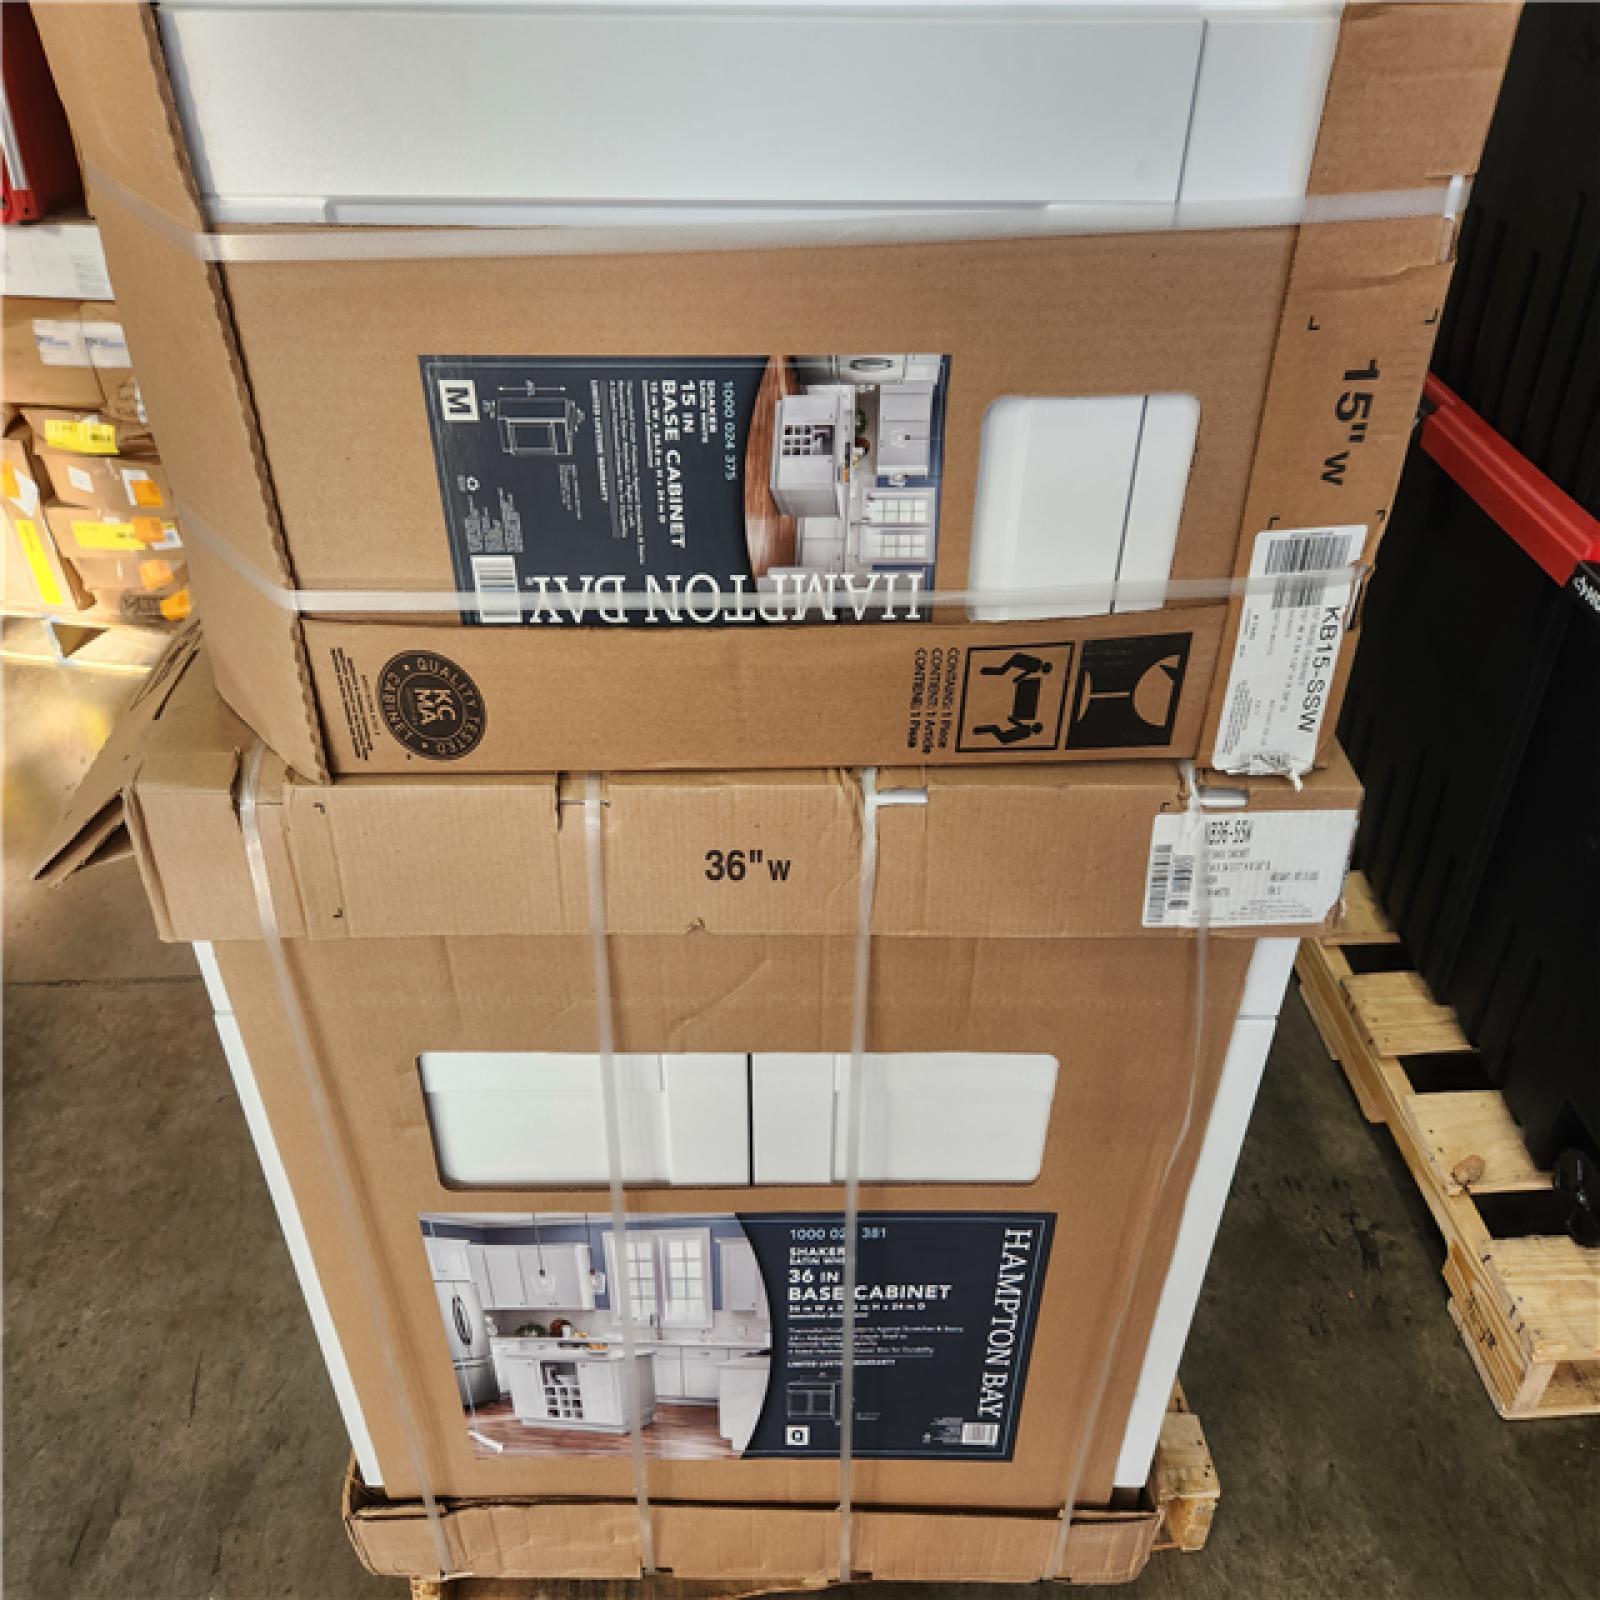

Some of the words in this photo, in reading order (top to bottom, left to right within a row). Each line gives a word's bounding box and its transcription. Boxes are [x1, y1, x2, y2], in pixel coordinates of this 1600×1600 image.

[445, 386, 473, 414] M
[662, 380, 681, 440] BASE
[680, 380, 696, 405] 15
[682, 412, 696, 433] IN
[666, 449, 686, 548] CABINET
[529, 575, 626, 623] BAY
[1297, 606, 1341, 732] KB15-SSW
[790, 1227, 825, 1240] 1000
[789, 1269, 814, 1284] 36
[819, 1271, 839, 1284] IN
[789, 1286, 846, 1302] BASE
[854, 1284, 952, 1302] CABINET
[985, 1229, 1033, 1366] HAMPTON
[977, 1372, 1008, 1418] BAY
